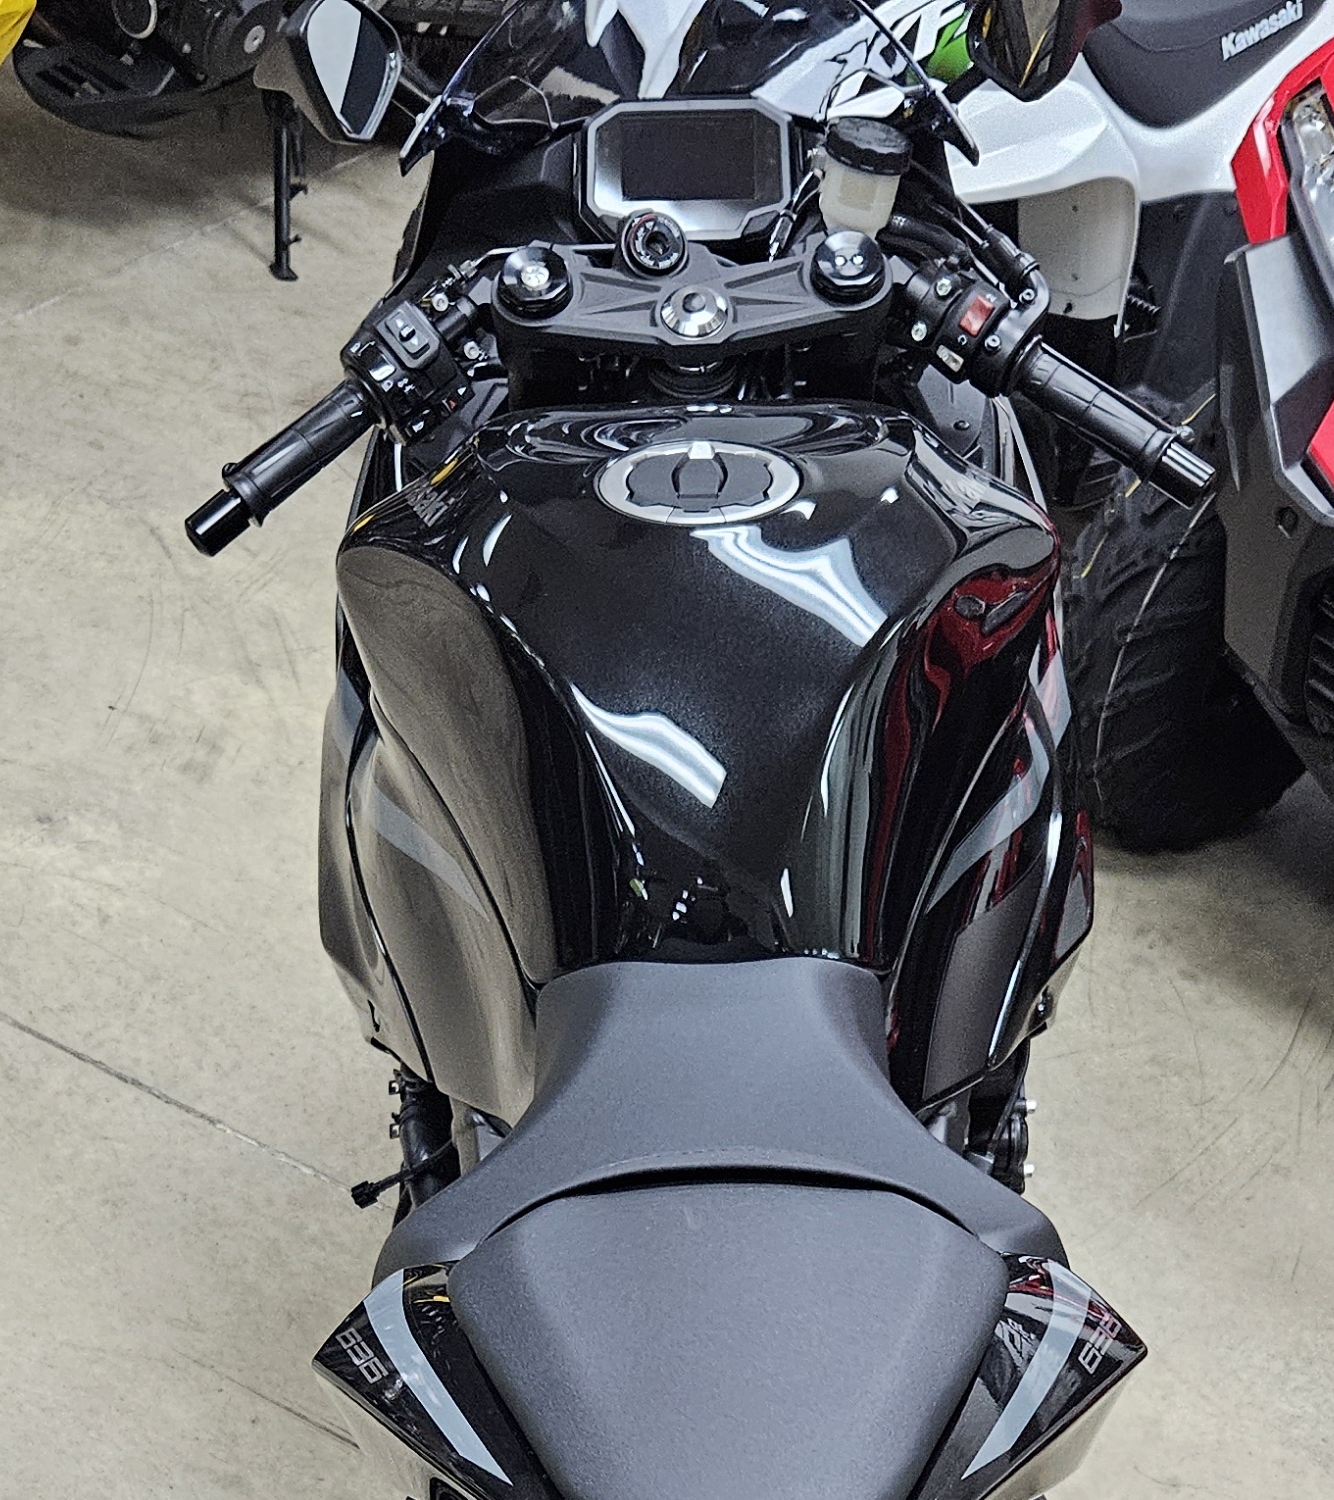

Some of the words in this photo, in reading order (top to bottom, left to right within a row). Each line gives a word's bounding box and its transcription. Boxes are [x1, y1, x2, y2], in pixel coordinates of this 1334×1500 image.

[1221, 0, 1303, 61] Kawasaki
[335, 1327, 389, 1384] 636
[1078, 1313, 1122, 1375] 636
